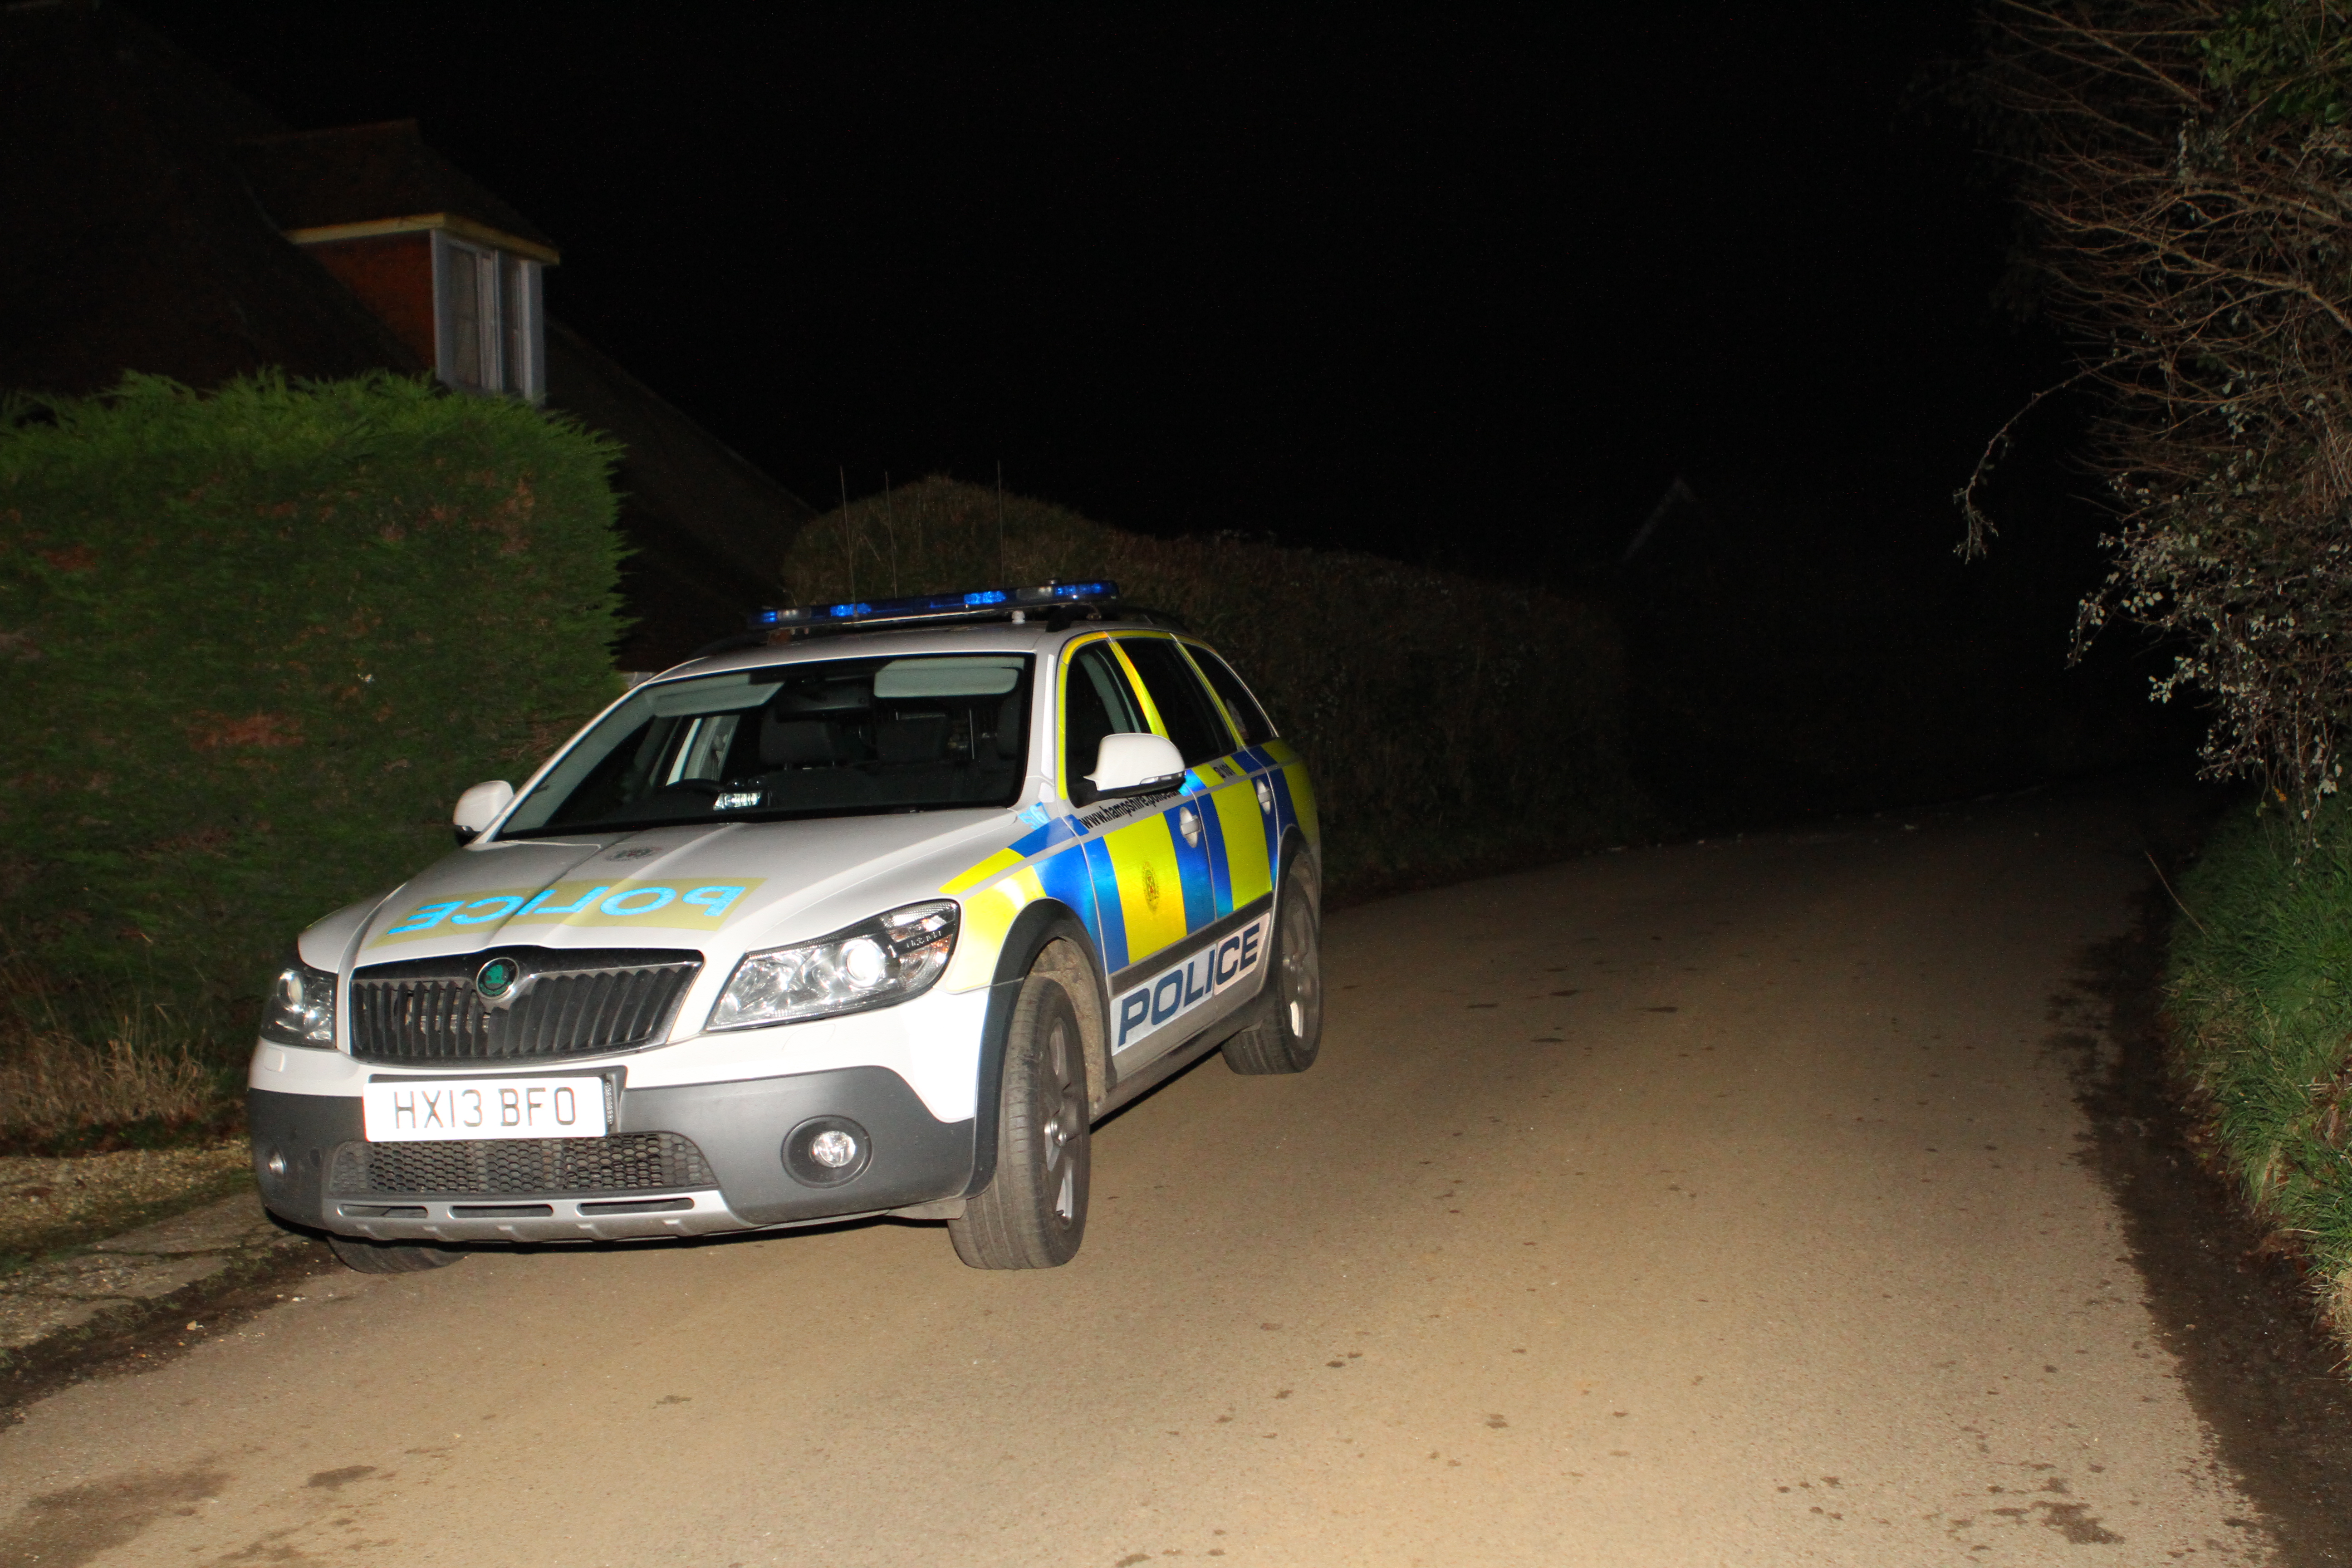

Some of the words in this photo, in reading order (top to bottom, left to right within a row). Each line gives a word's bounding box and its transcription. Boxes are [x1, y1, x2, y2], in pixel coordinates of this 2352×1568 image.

[1117, 922, 1260, 1048] POLICE
[394, 1089, 482, 1129] HX13
[498, 1087, 576, 1127] BFO
